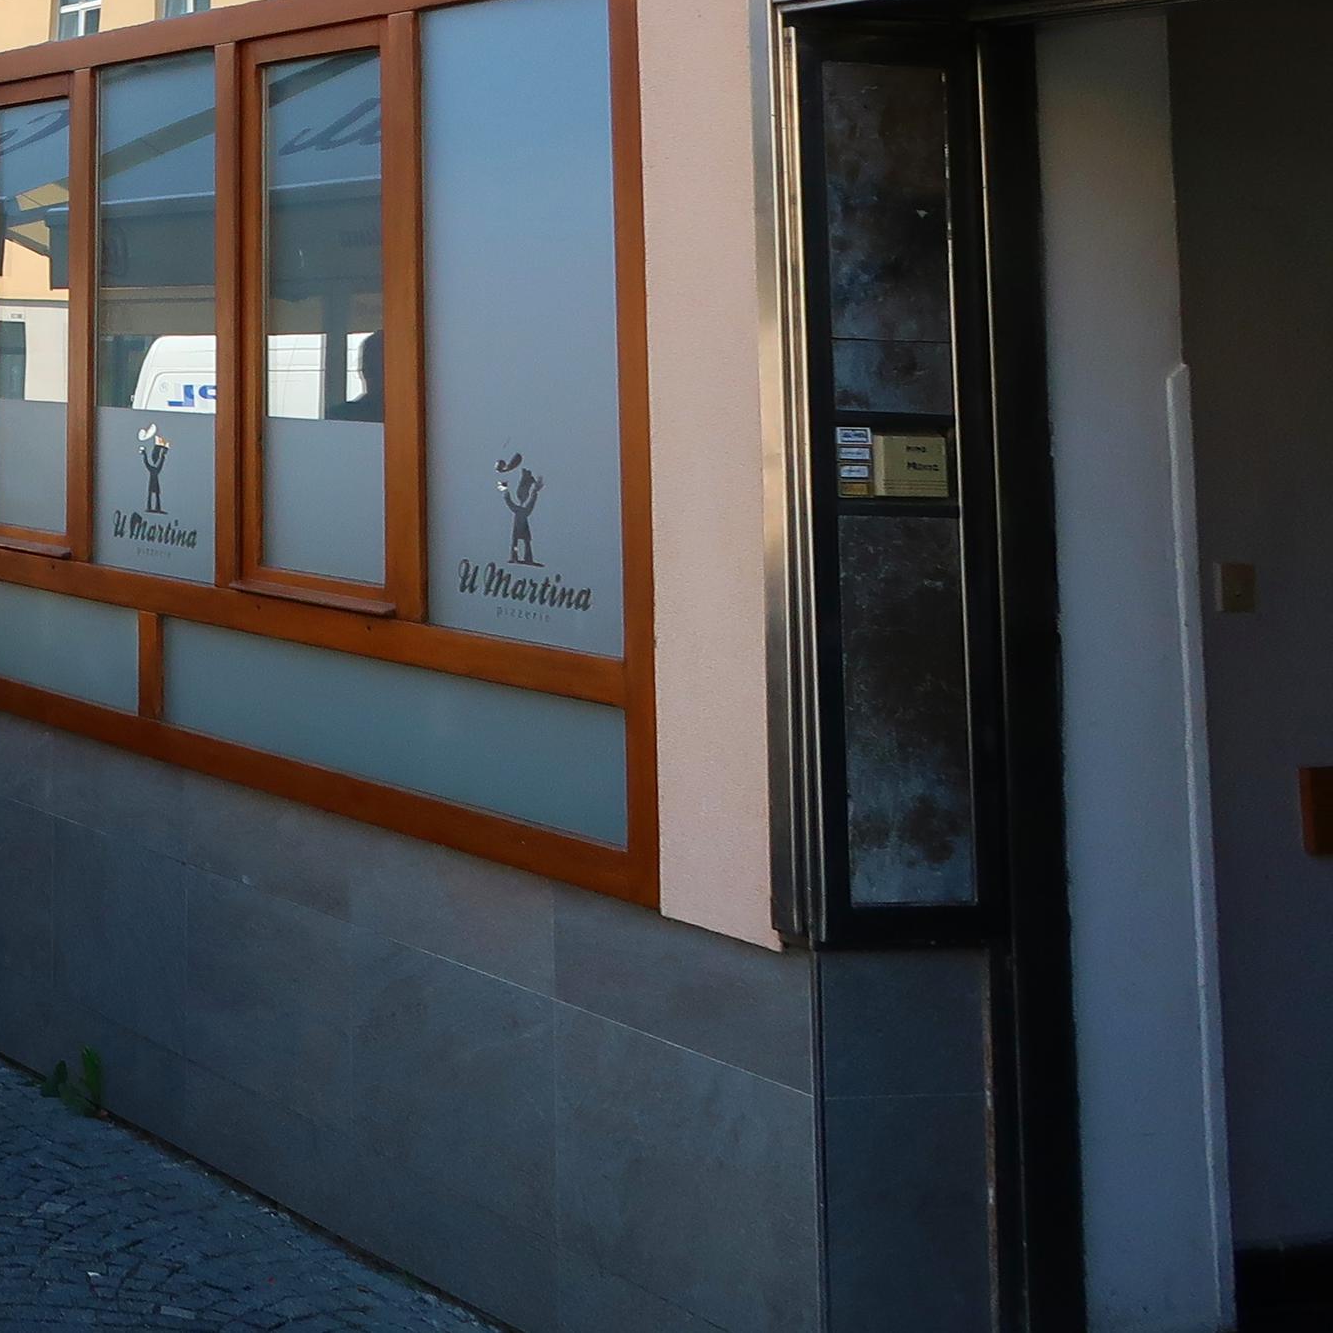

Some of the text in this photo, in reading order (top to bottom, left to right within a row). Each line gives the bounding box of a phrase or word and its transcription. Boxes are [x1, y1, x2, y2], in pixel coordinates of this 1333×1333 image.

[113, 510, 198, 549] U Martina
[459, 559, 592, 612] U Martina
[496, 606, 550, 623] pizzerie
